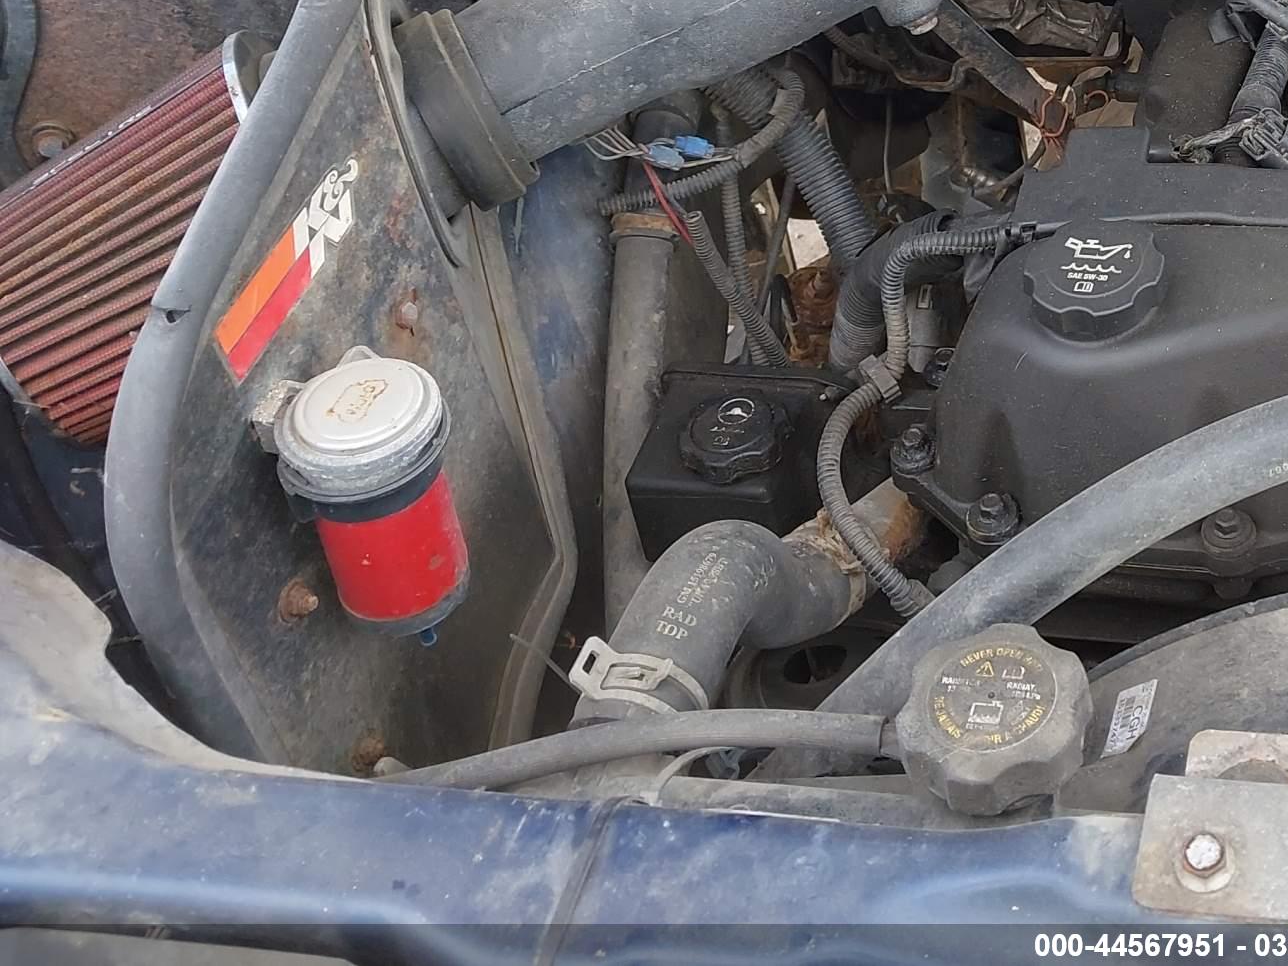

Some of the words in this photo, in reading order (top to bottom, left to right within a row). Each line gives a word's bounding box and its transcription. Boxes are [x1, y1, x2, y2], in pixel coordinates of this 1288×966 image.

[292, 158, 359, 280] K&N
[1066, 271, 1083, 279] SAE
[1083, 272, 1108, 282] 5W-30
[662, 605, 697, 627] RAD
[655, 619, 689, 640] TOP
[959, 647, 994, 667] NEVER
[996, 647, 1024, 660] OPEN
[1125, 705, 1144, 741] CGH
